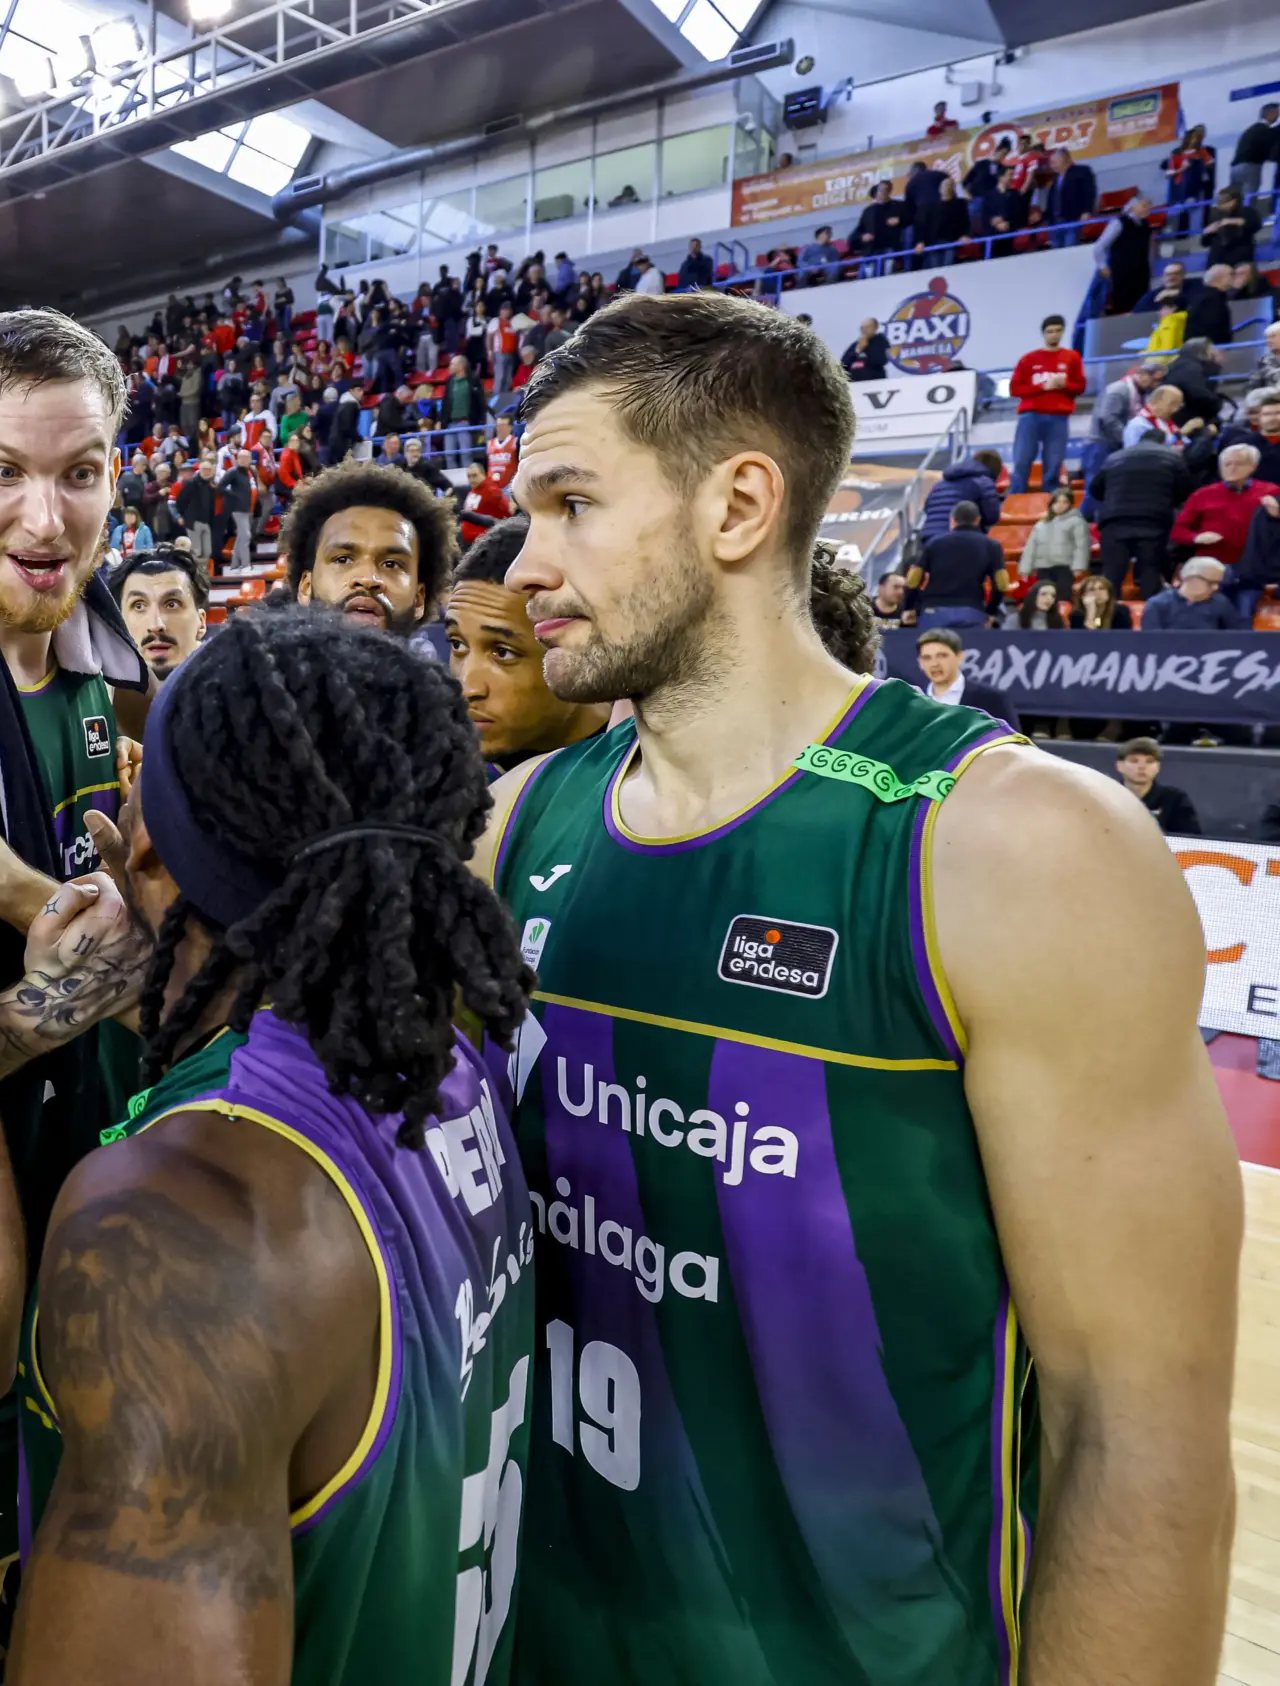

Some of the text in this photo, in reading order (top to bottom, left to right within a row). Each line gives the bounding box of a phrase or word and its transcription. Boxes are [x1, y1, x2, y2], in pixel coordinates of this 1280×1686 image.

[887, 312, 967, 346] BAXI
[732, 935, 775, 960] liga
[729, 957, 820, 988] endesa
[556, 1056, 800, 1187] Unicaja
[546, 1318, 642, 1492] 19
